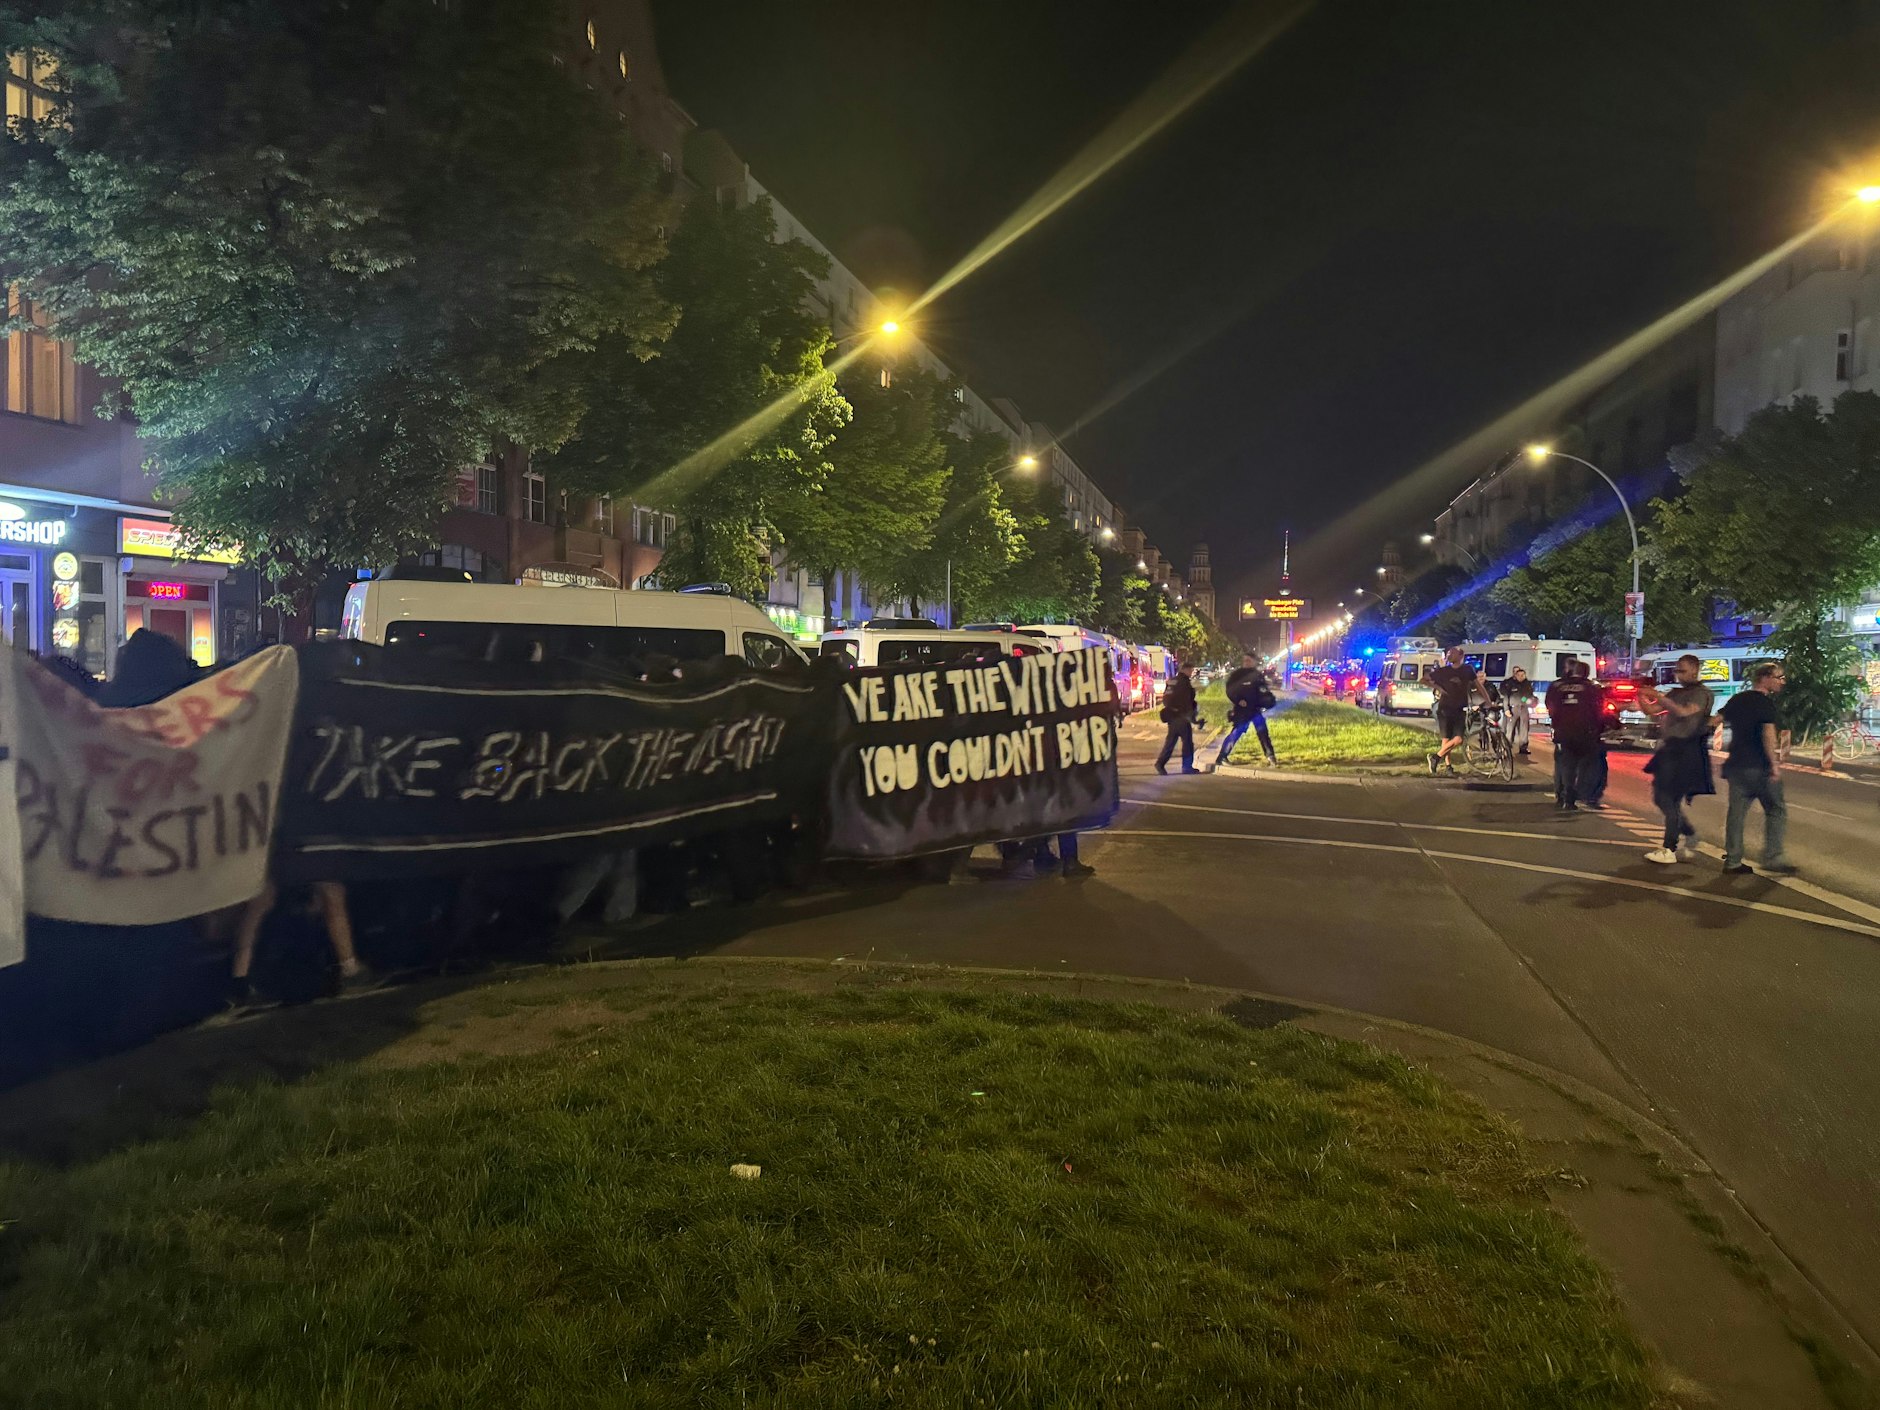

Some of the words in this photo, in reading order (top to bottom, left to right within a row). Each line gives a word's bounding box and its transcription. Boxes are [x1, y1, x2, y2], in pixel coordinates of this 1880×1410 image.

[0, 520, 66, 545] RSHOP
[150, 585, 181, 598] OPEN
[892, 671, 944, 722] ARE
[945, 667, 1007, 715] THE
[998, 646, 1112, 716] WITCHE
[309, 725, 462, 801] TAKE
[460, 731, 622, 801] BACK
[625, 728, 696, 791] THE
[860, 744, 918, 797] YOU
[928, 720, 1045, 789] COULDN'T
[1056, 715, 1111, 769] BUR
